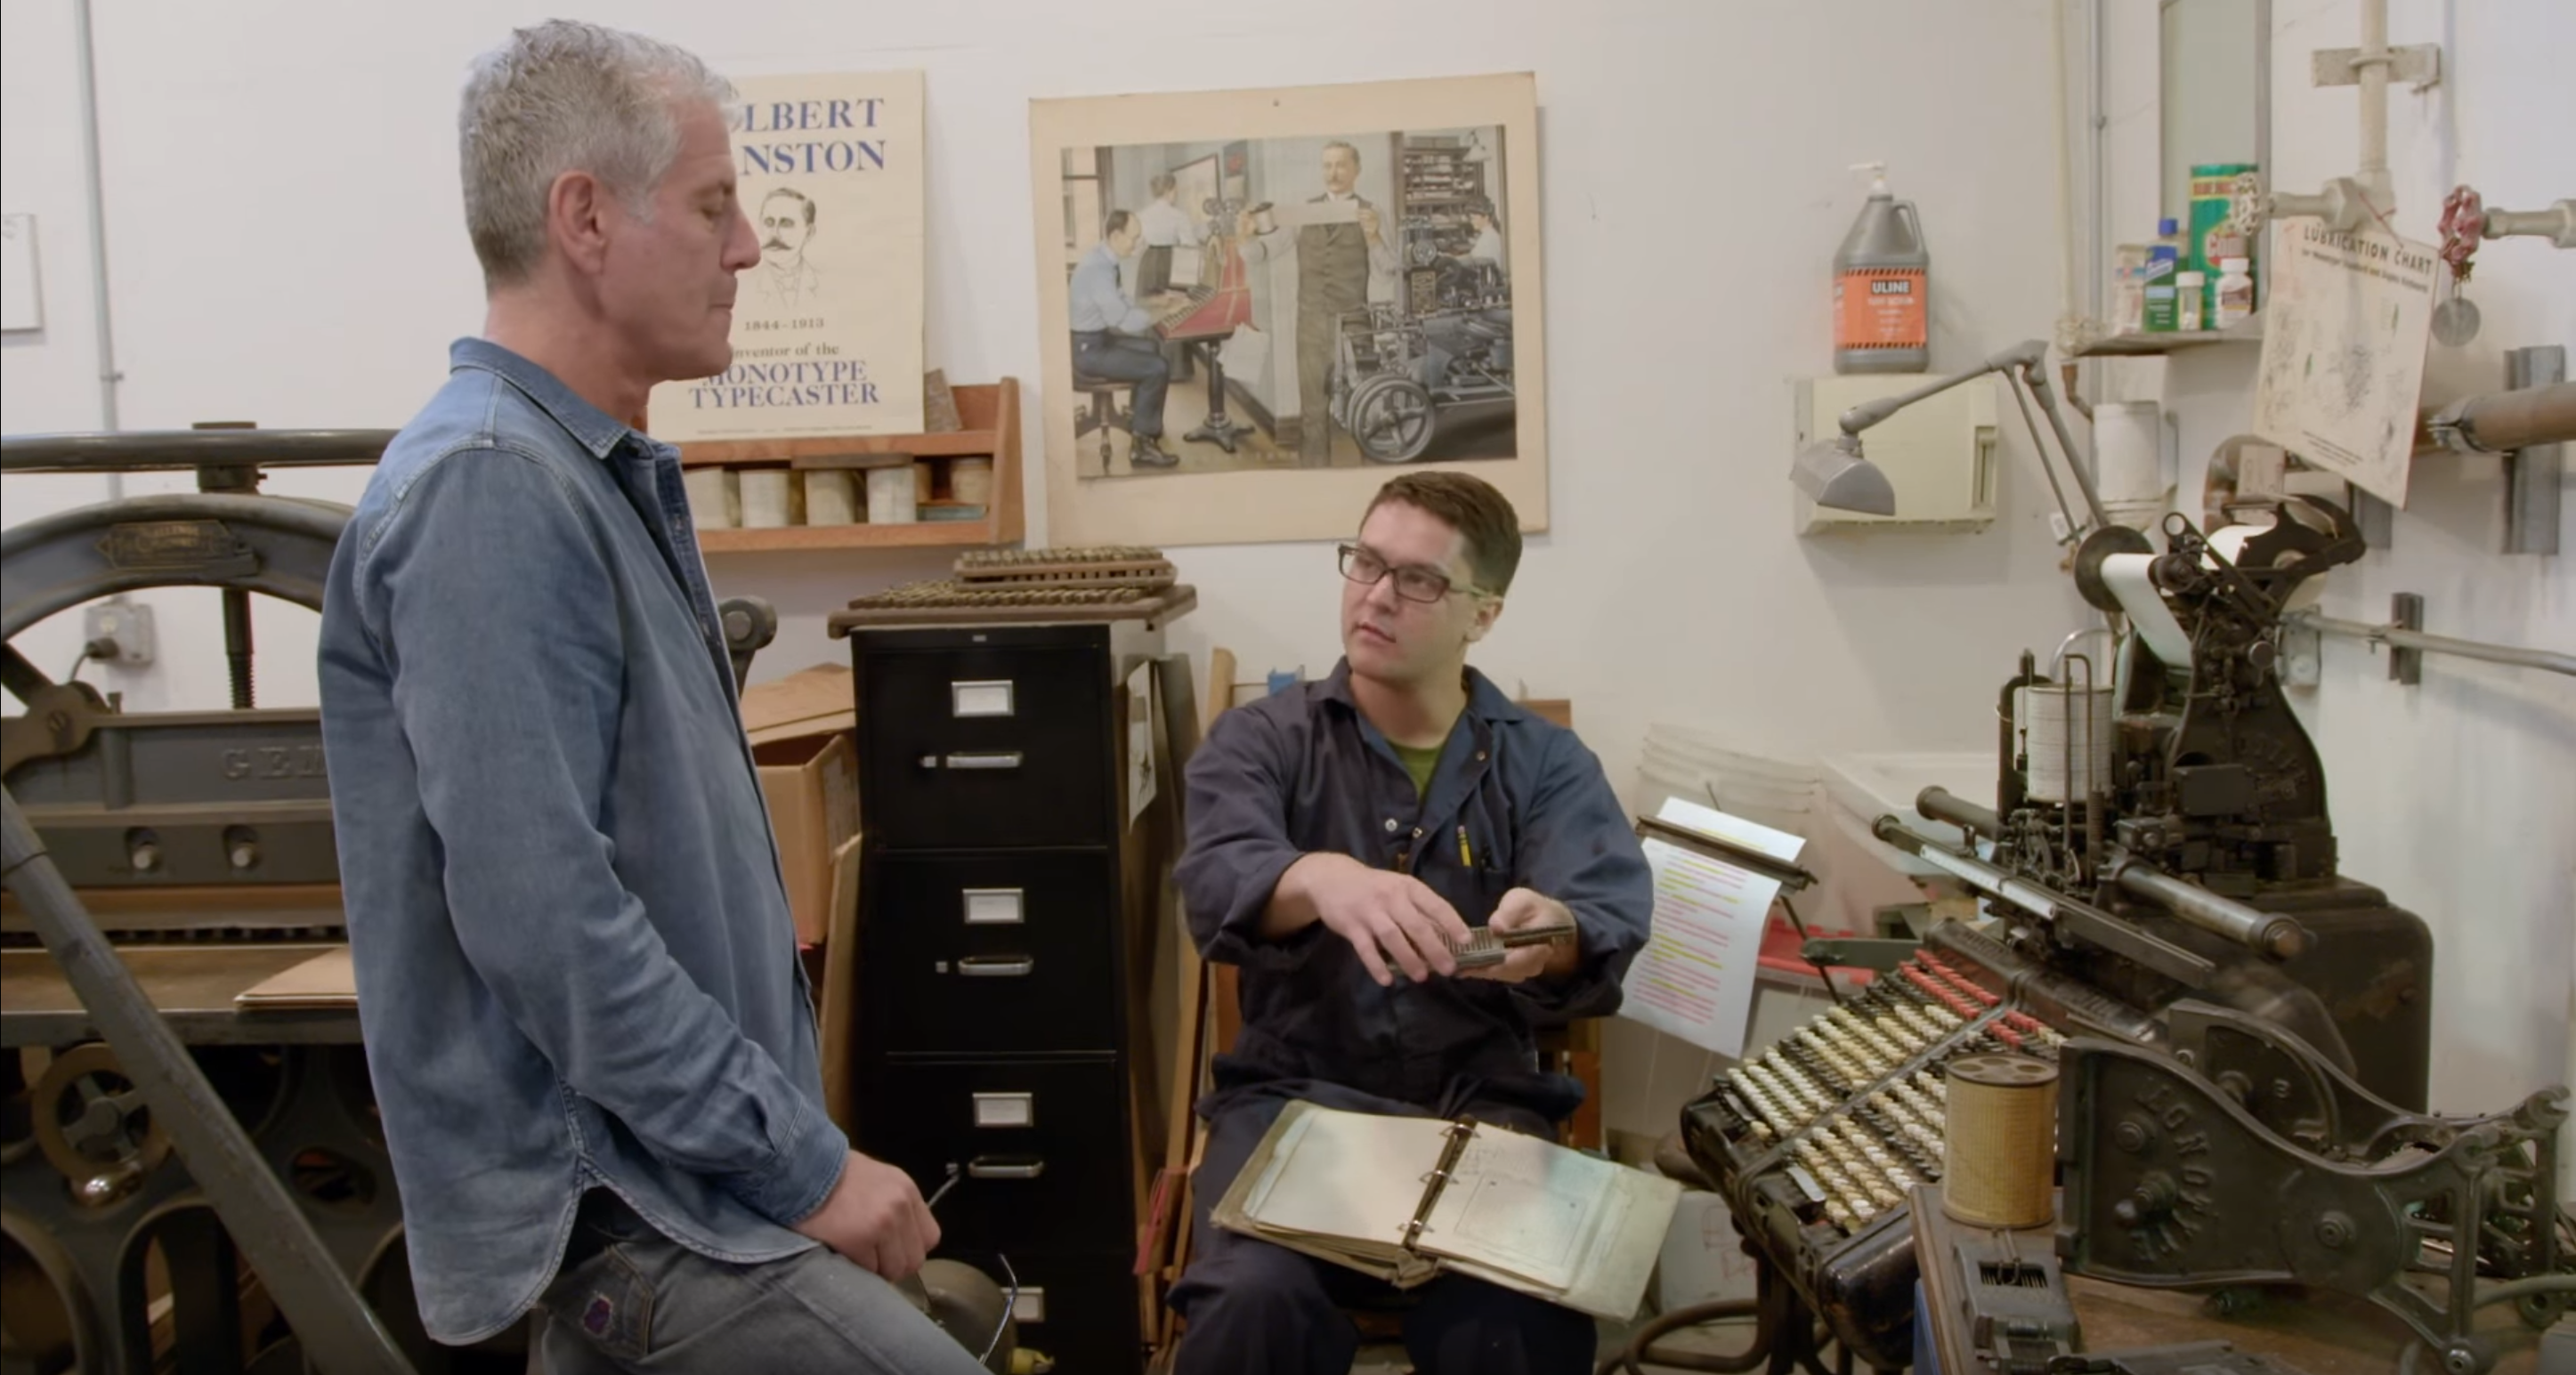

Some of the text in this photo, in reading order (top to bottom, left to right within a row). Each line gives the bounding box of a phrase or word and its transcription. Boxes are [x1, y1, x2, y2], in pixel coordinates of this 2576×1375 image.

[741, 99, 885, 133] LBERT
[741, 140, 887, 176] NSTON
[2304, 225, 2433, 275] LUBRICATION CHART
[1872, 280, 1909, 295] ULINE
[734, 341, 838, 358] nventor of the
[688, 383, 880, 409] TYPECASTER
